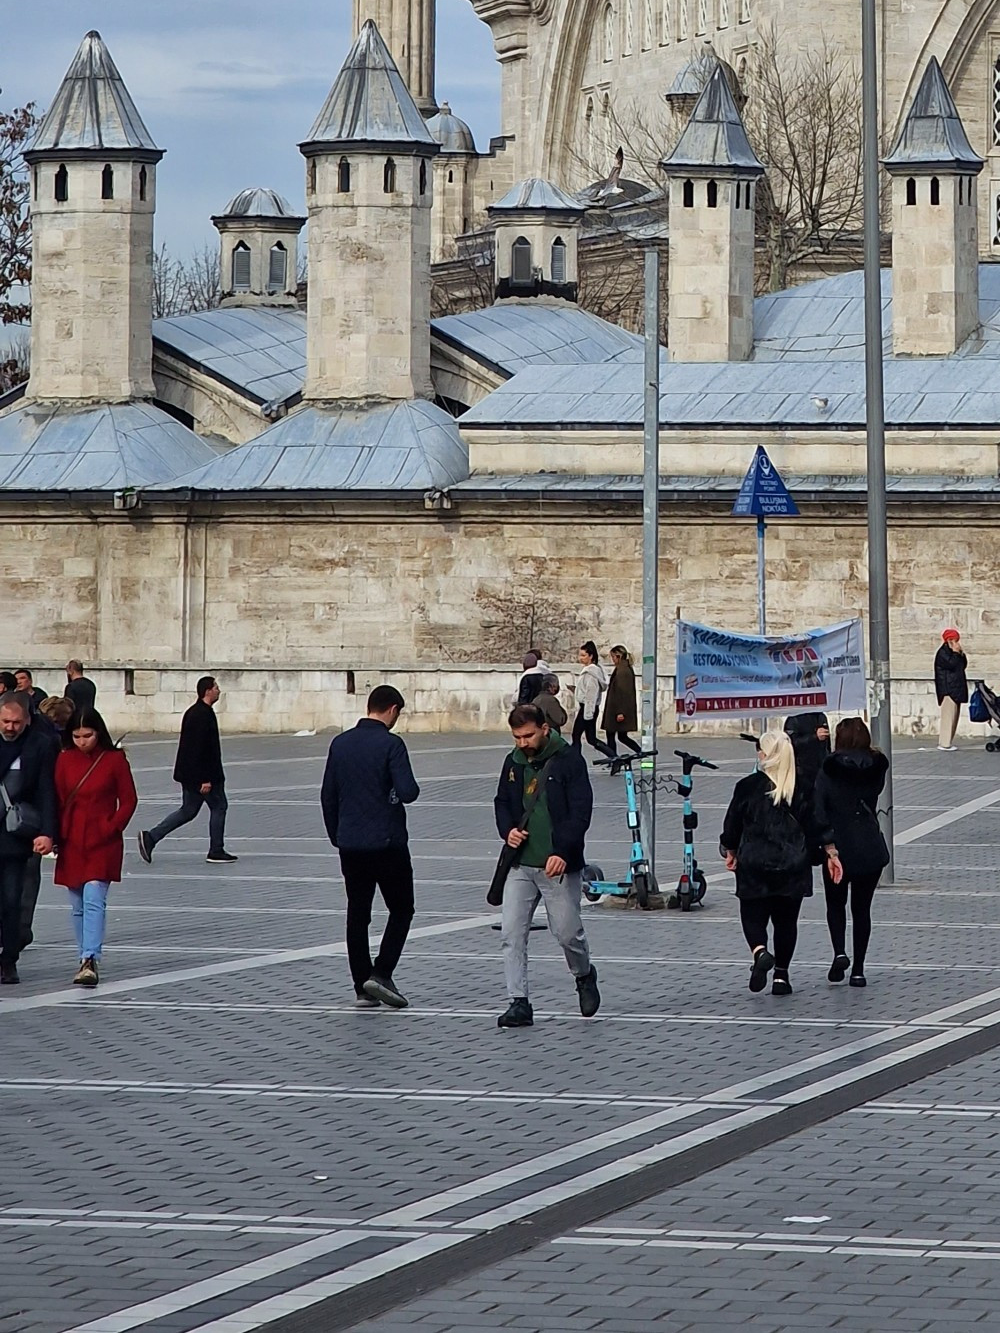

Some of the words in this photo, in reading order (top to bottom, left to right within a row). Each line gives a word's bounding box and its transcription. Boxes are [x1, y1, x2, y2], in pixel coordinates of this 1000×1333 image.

[759, 496, 788, 506] BULUŞMA
[762, 505, 788, 513] NOKTASI
[706, 698, 740, 710] FATİH
[748, 693, 817, 708] BELEDİYESİ
